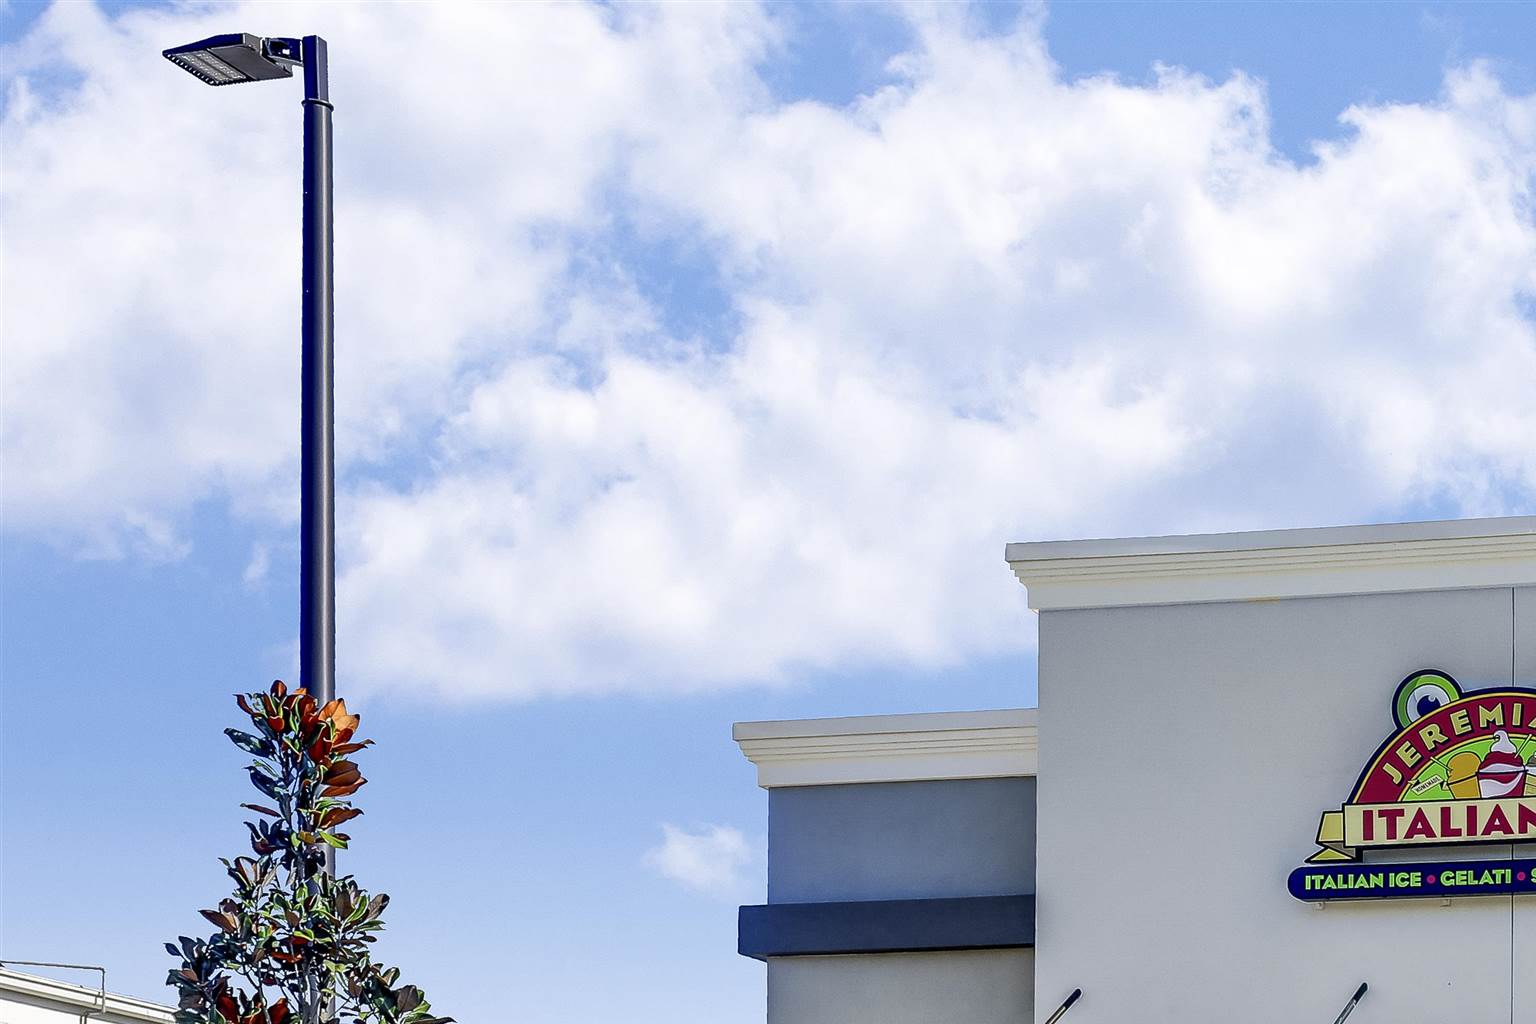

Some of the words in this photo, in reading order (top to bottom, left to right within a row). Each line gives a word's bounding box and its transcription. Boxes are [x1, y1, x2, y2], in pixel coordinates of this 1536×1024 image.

[1305, 872, 1384, 890] ITALIAN
[1389, 872, 1422, 887] ICE
[1440, 869, 1512, 886] GELATI
